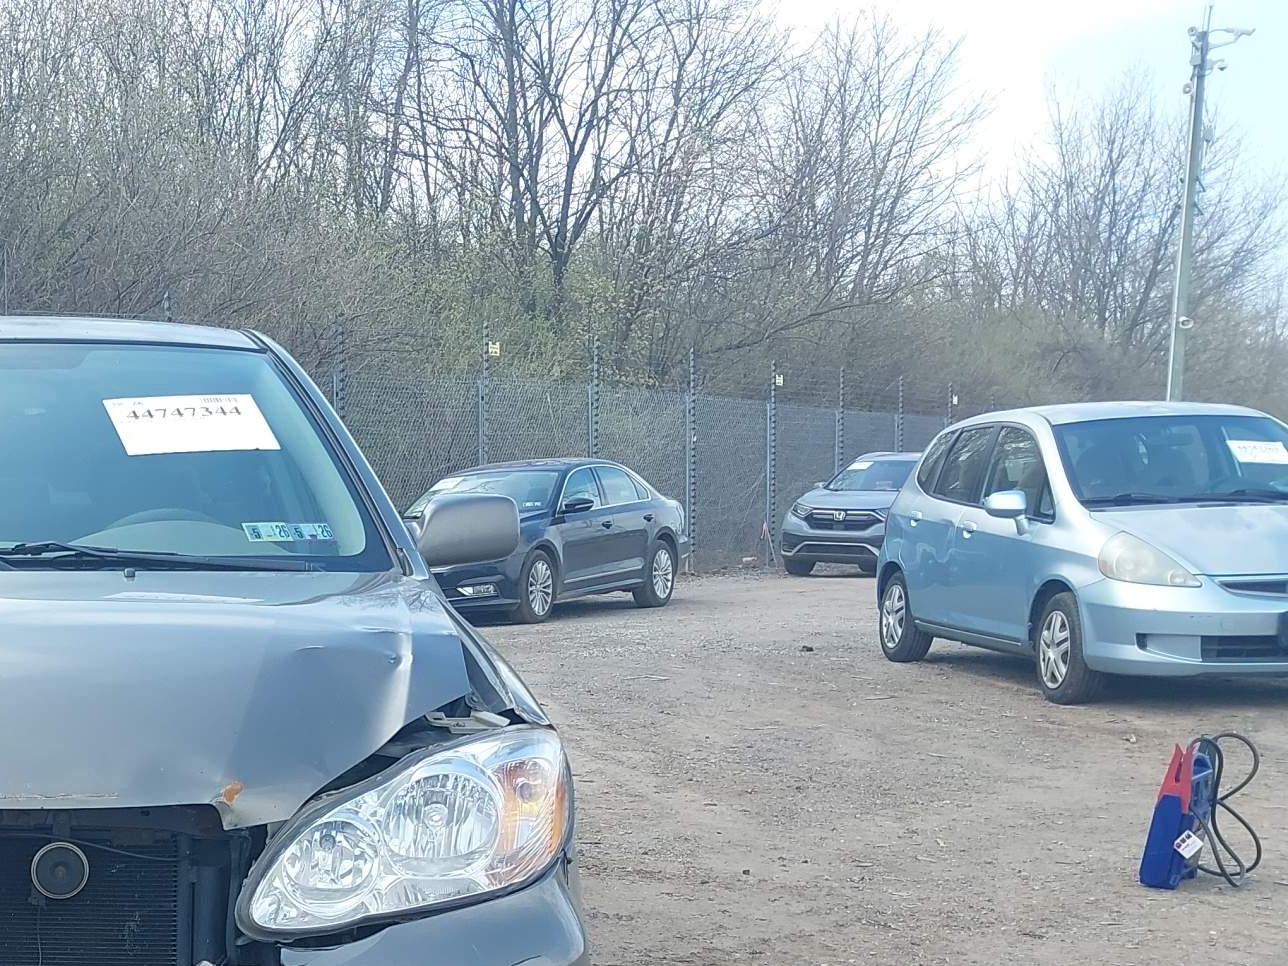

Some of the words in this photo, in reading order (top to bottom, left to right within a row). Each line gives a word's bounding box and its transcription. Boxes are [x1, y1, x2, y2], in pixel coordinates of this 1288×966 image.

[126, 405, 242, 420] 44747344
[275, 524, 290, 538] 26
[317, 524, 333, 538] 26
